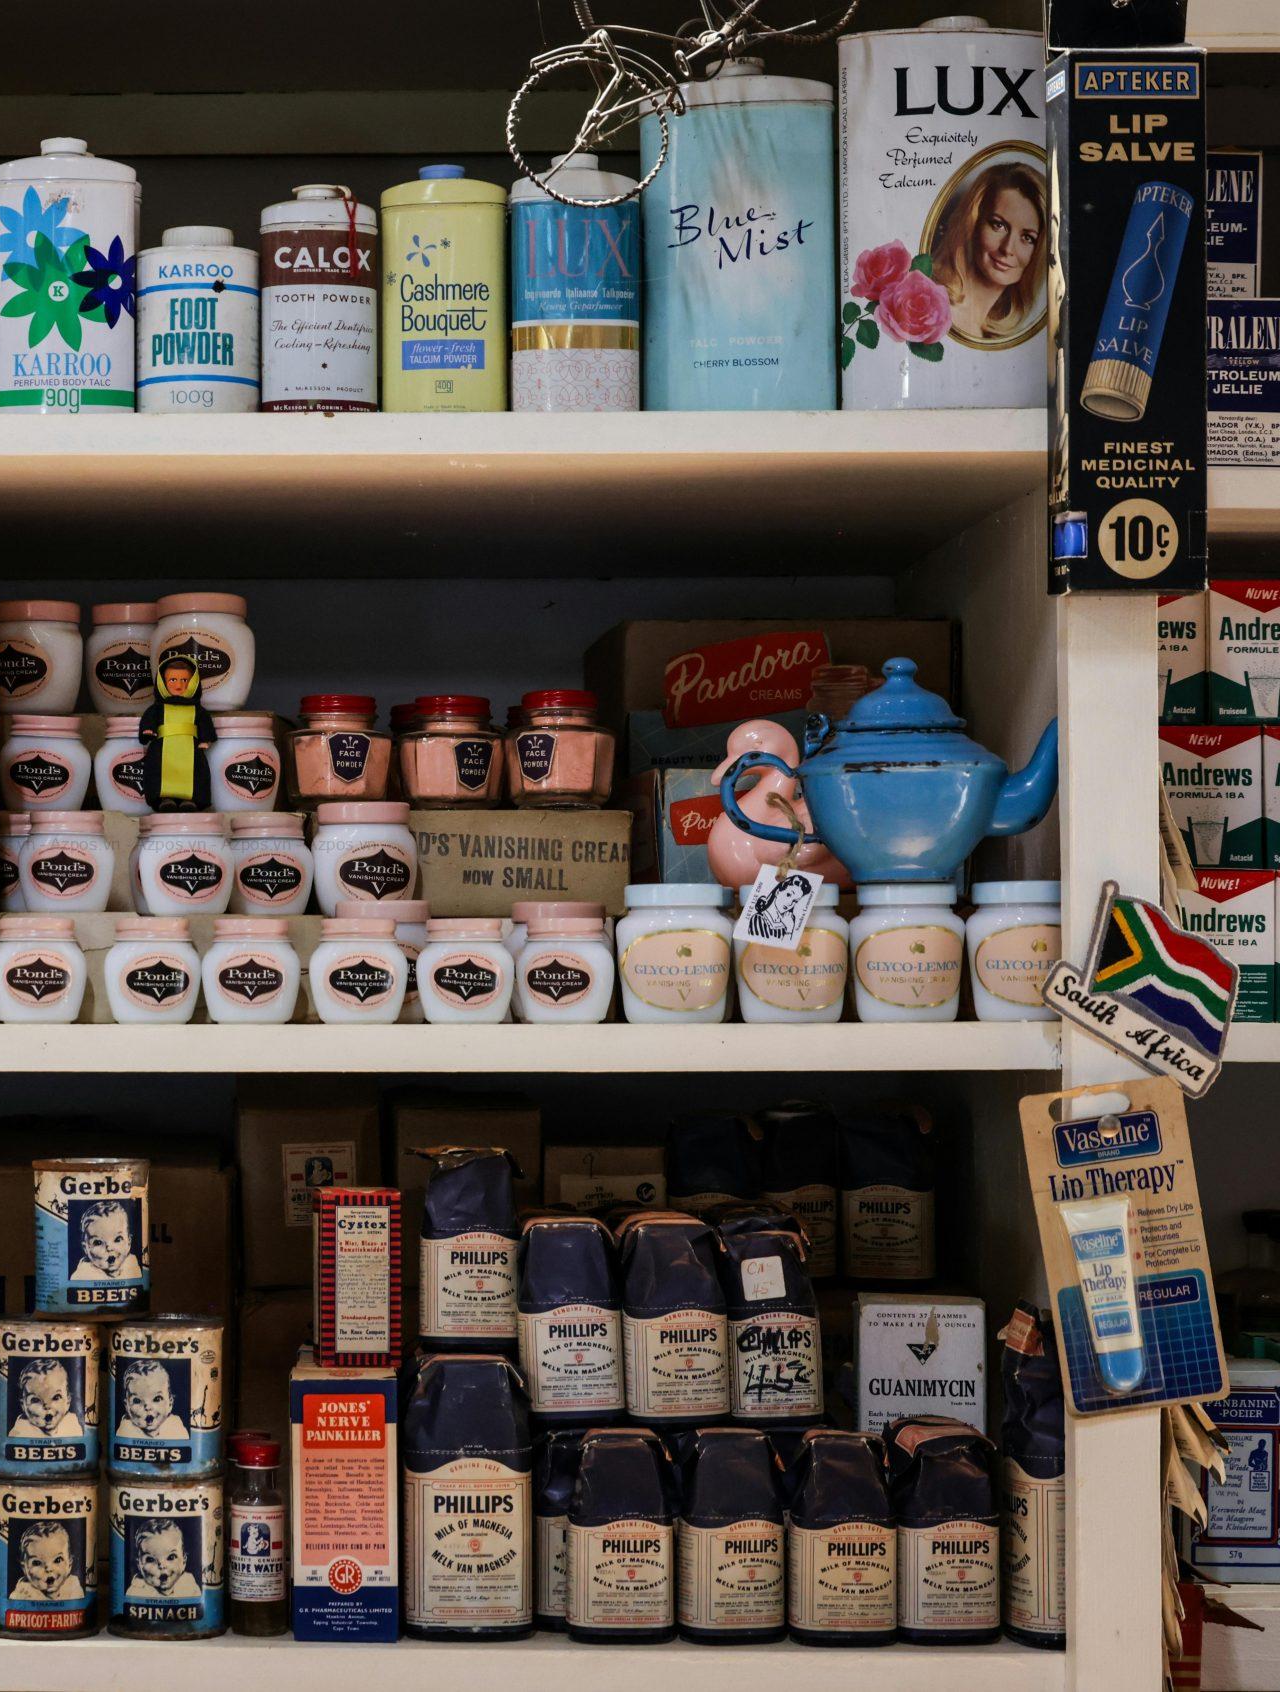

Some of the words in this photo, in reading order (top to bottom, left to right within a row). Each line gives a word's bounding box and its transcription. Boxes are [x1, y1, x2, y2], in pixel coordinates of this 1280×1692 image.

[1084, 72, 1190, 90] APTEKER
[894, 66, 1038, 118] LUX
[1110, 114, 1168, 133] LIP
[906, 127, 977, 146] Exquisitely
[887, 149, 952, 166] Perfumed
[1080, 142, 1195, 162] SALVE
[879, 173, 936, 188] Talcum.
[668, 204, 776, 248] Blue
[526, 219, 632, 278] LUX
[718, 219, 814, 269] Mist
[275, 247, 371, 271] CALOX
[159, 264, 234, 278] KARROO
[401, 273, 490, 302] Cashmere
[275, 294, 315, 303] TOOTH
[323, 294, 371, 304] POWDER
[170, 297, 217, 330] FOOT
[402, 305, 487, 336] Bouquet
[152, 332, 234, 367] POWDER
[13, 353, 111, 377] KARROO
[410, 355, 440, 363] TALCUM
[444, 354, 477, 363] POWDER
[693, 358, 730, 369] CHERRY
[733, 357, 779, 367] BLOSSOM
[14, 379, 60, 387] PERFUMED
[62, 379, 86, 387] BODY
[89, 378, 111, 386] TALC
[1213, 384, 1262, 394] JELLIE
[46, 389, 81, 412] 90g
[170, 389, 214, 407] 100g
[1104, 442, 1174, 454] FINEST
[1081, 460, 1195, 471] MEDICINAL
[1096, 476, 1180, 489] QUALITY
[666, 640, 820, 722] Pandora
[749, 688, 803, 700] CREAMS
[1189, 734, 1221, 746] NEW!
[339, 750, 361, 758] FACE
[1163, 763, 1252, 786] Andrews
[460, 836, 563, 861] VANISHING
[39, 861, 86, 872] Pond's
[353, 860, 404, 874] Pond's
[463, 870, 493, 885] NOW
[502, 868, 568, 891] SMALL
[866, 961, 961, 972] GLYCO-LEMON
[1055, 976, 1119, 1026] South
[1126, 1028, 1205, 1081] Africa
[1048, 1174, 1084, 1201] Lip
[1086, 1162, 1177, 1196] Therapy
[1138, 1207, 1165, 1216] Relieves
[1168, 1204, 1178, 1214] Dry
[1180, 1203, 1193, 1211] Lips
[338, 1220, 387, 1230] Cystex
[1075, 1234, 1119, 1250] Vaseline
[1139, 1285, 1191, 1301] REGULAR
[869, 1379, 975, 1397] GUANIMYCIN
[319, 1401, 371, 1413] JONES'
[318, 1417, 370, 1427] NERVE
[306, 1430, 381, 1441] PAINKILLER
[14, 1446, 76, 1460] BEETS
[120, 1490, 209, 1513] Gerber's
[434, 1495, 514, 1514] PHILLIPS
[434, 1526, 455, 1541] MILK
[458, 1519, 468, 1529] OF
[473, 1519, 513, 1540] MAGNESIA
[932, 1540, 990, 1555] PHILLIPS
[1229, 1550, 1243, 1559] 57g
[335, 1564, 354, 1584] GR
[129, 1606, 197, 1619] SPINACH
